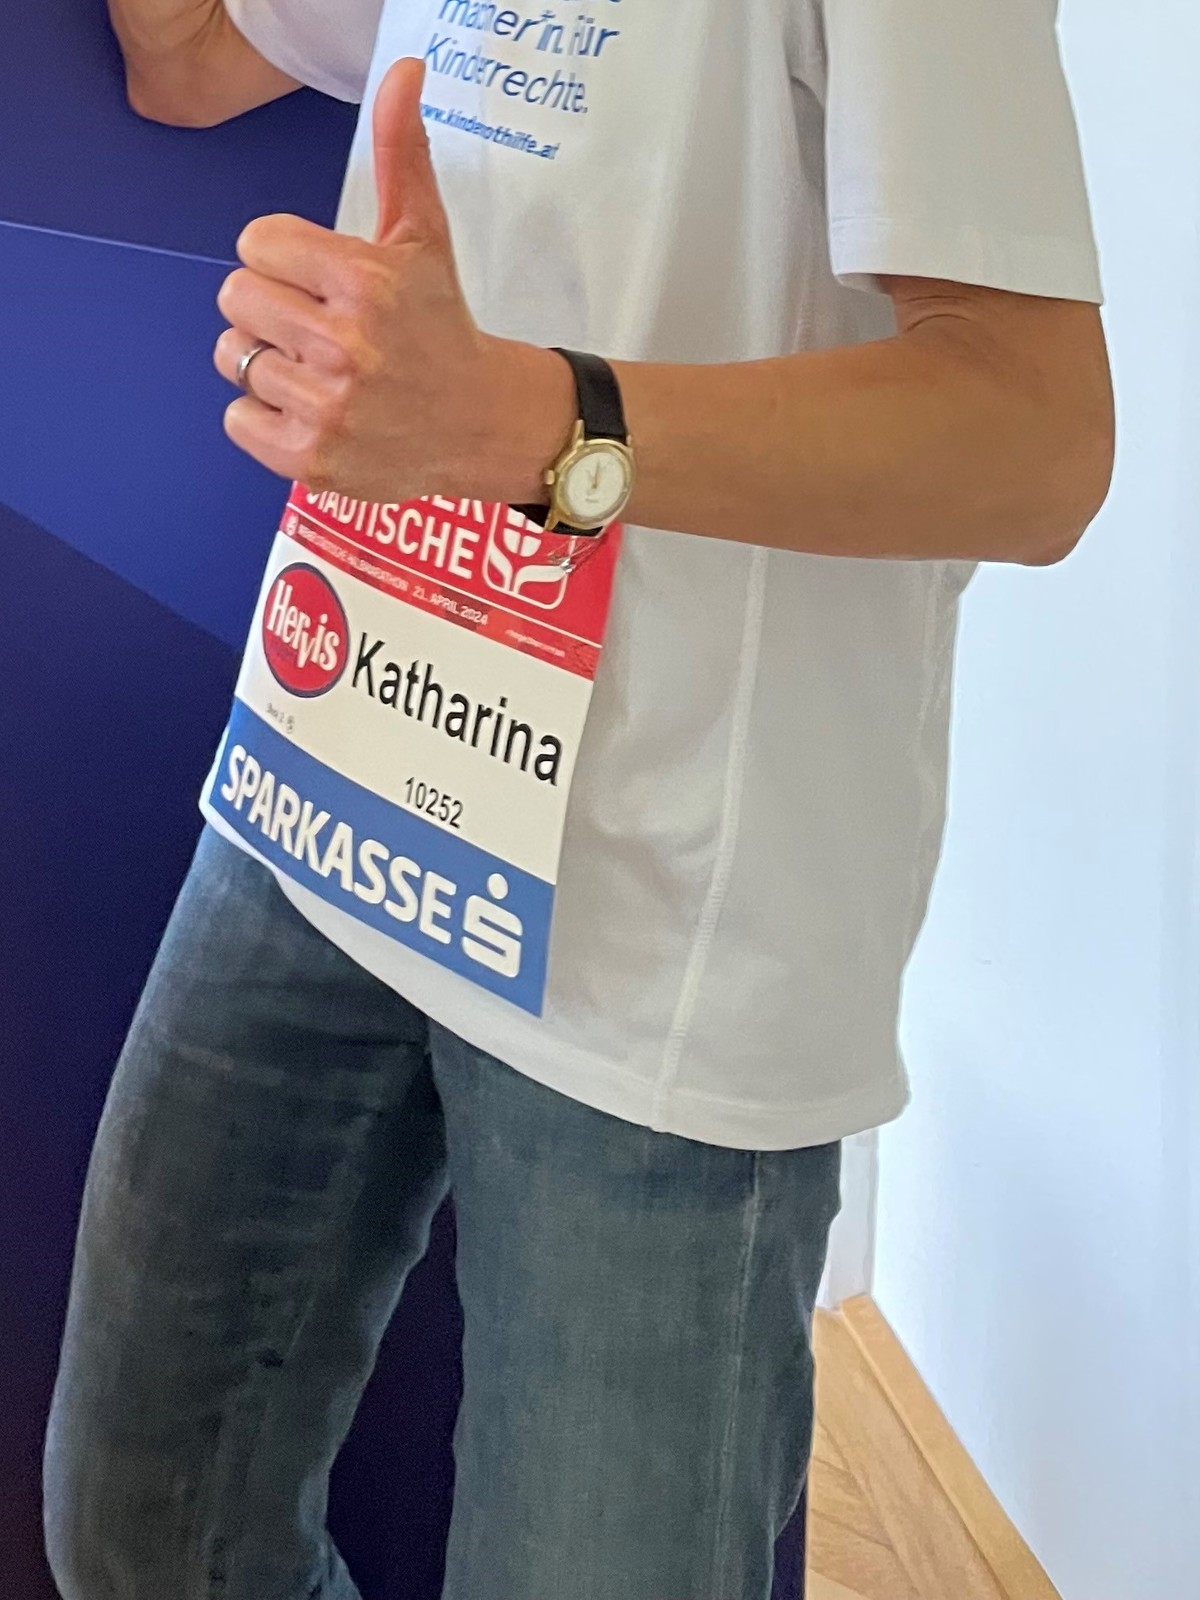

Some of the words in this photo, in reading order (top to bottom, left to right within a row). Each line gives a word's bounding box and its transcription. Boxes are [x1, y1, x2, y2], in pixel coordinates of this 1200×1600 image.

[266, 578, 341, 670] Hervis
[429, 593, 460, 614] APRIL
[459, 606, 489, 626] 2024
[352, 631, 564, 786] Katharina
[220, 743, 458, 945] SPARKASSE
[404, 776, 465, 829] 10252
